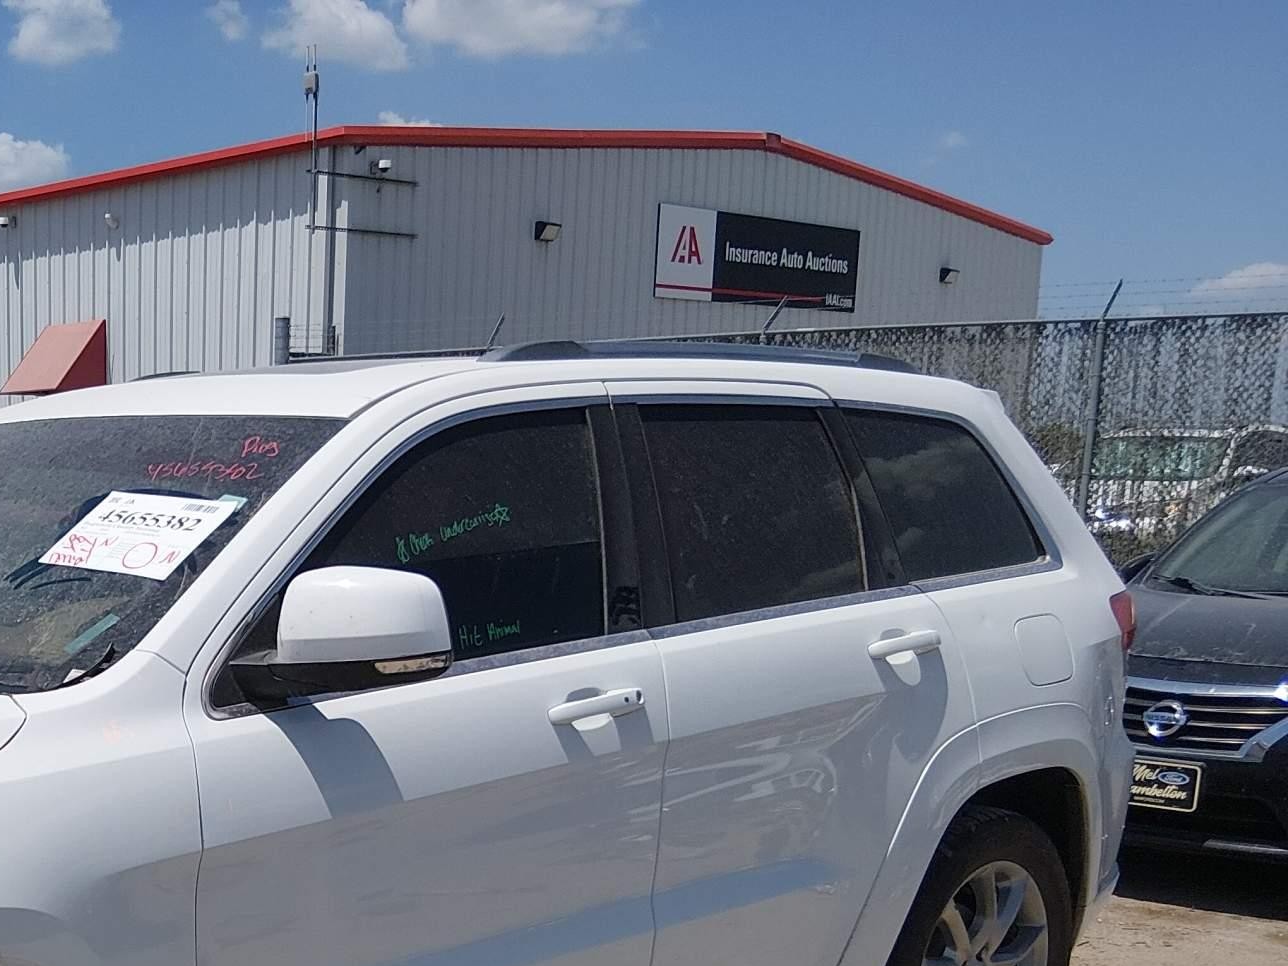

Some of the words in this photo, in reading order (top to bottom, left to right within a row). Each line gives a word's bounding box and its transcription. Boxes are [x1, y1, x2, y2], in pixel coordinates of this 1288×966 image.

[725, 241, 778, 266] Insurance
[780, 248, 804, 270] Auto
[805, 251, 849, 275] Auctions
[98, 509, 203, 532] 45655382
[1133, 764, 1161, 781] Mel
[1129, 783, 1188, 799] ambelton
